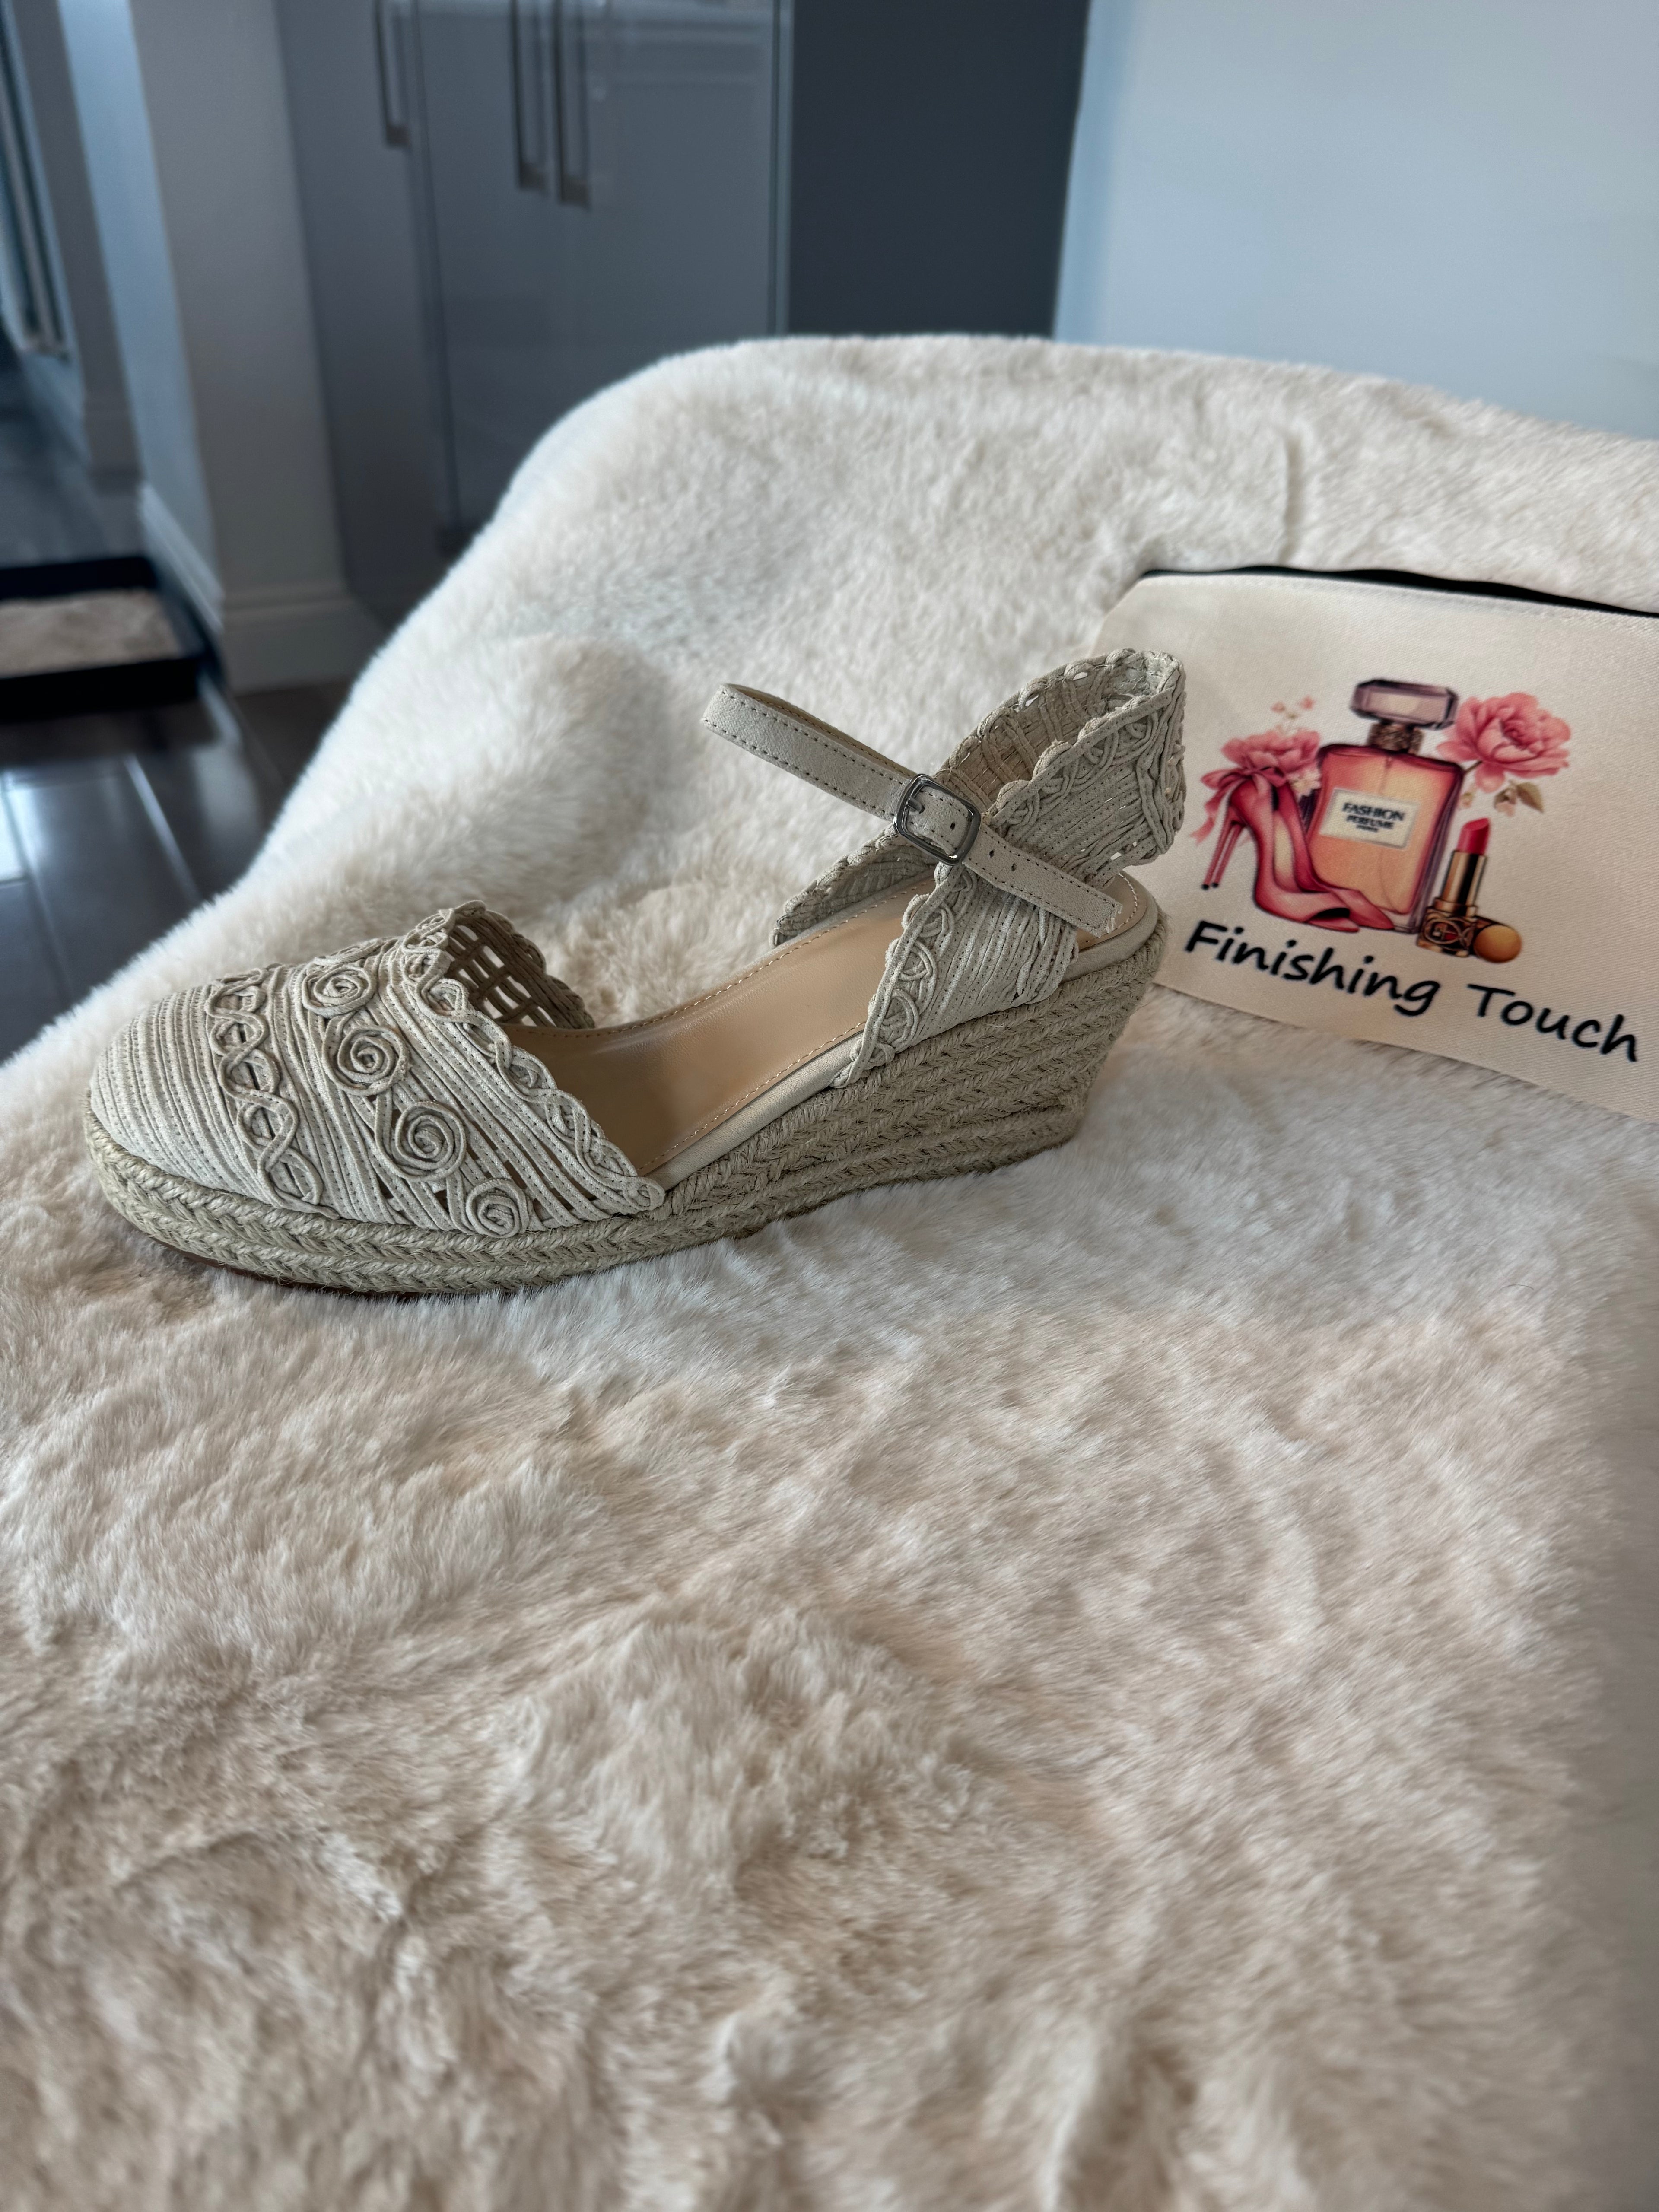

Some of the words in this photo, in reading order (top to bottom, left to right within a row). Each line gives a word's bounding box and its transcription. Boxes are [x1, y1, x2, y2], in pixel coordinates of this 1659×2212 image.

[1342, 802, 1406, 821] FASHION
[1184, 919, 1441, 1018] Finishing
[1466, 983, 1639, 1063] Touch
